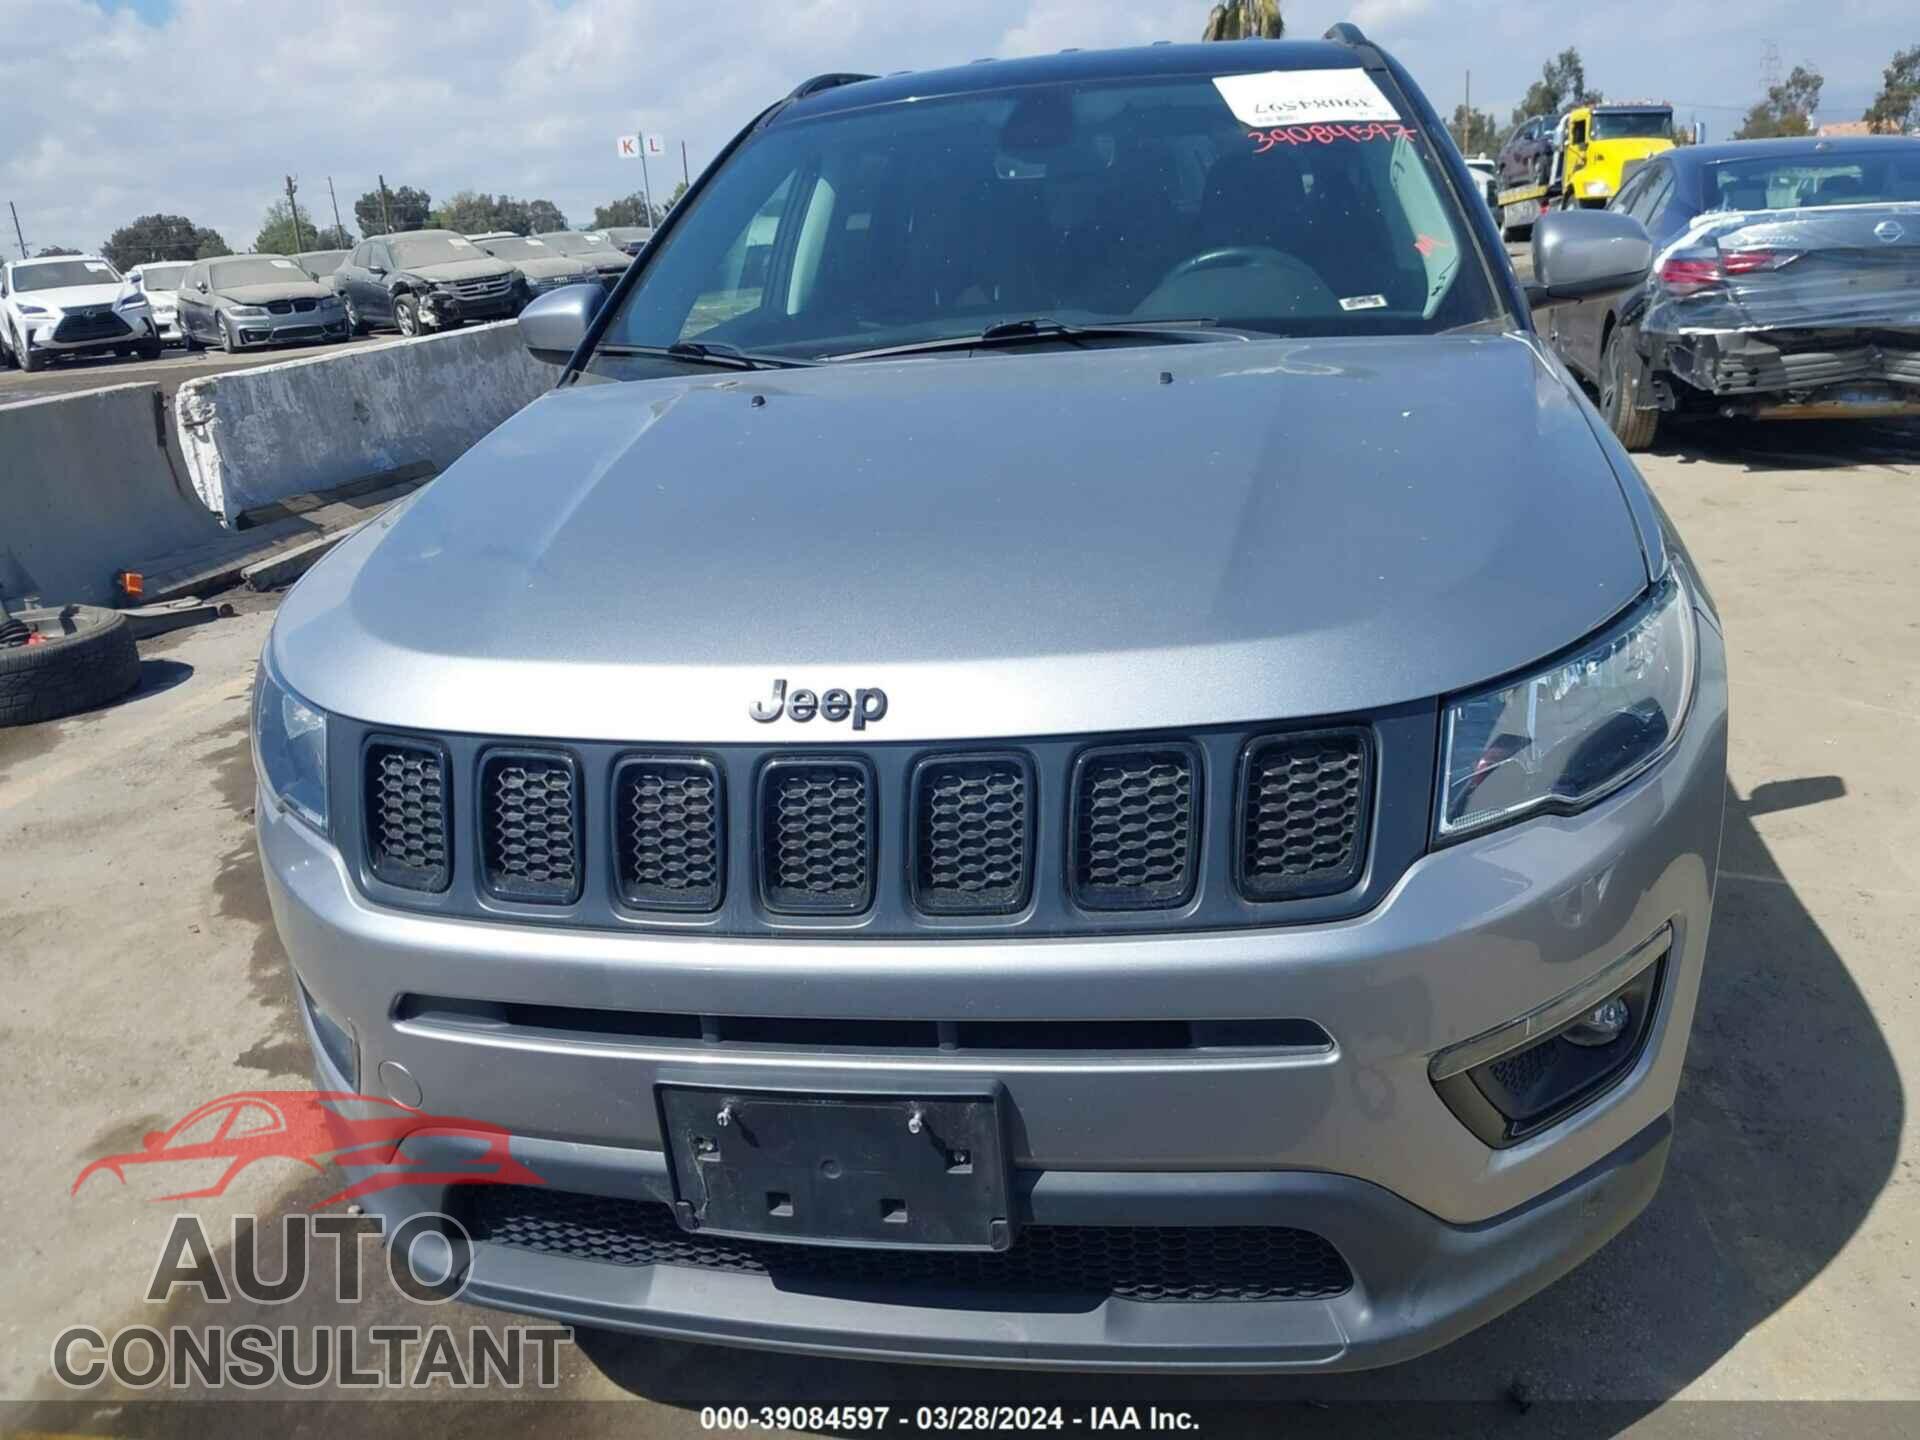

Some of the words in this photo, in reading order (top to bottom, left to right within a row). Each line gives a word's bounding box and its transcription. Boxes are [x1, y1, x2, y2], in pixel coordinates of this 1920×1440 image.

[623, 139, 635, 154] K
[649, 137, 661, 152] L
[1248, 122, 1417, 154] 39084597
[748, 679, 889, 731] Jeep
